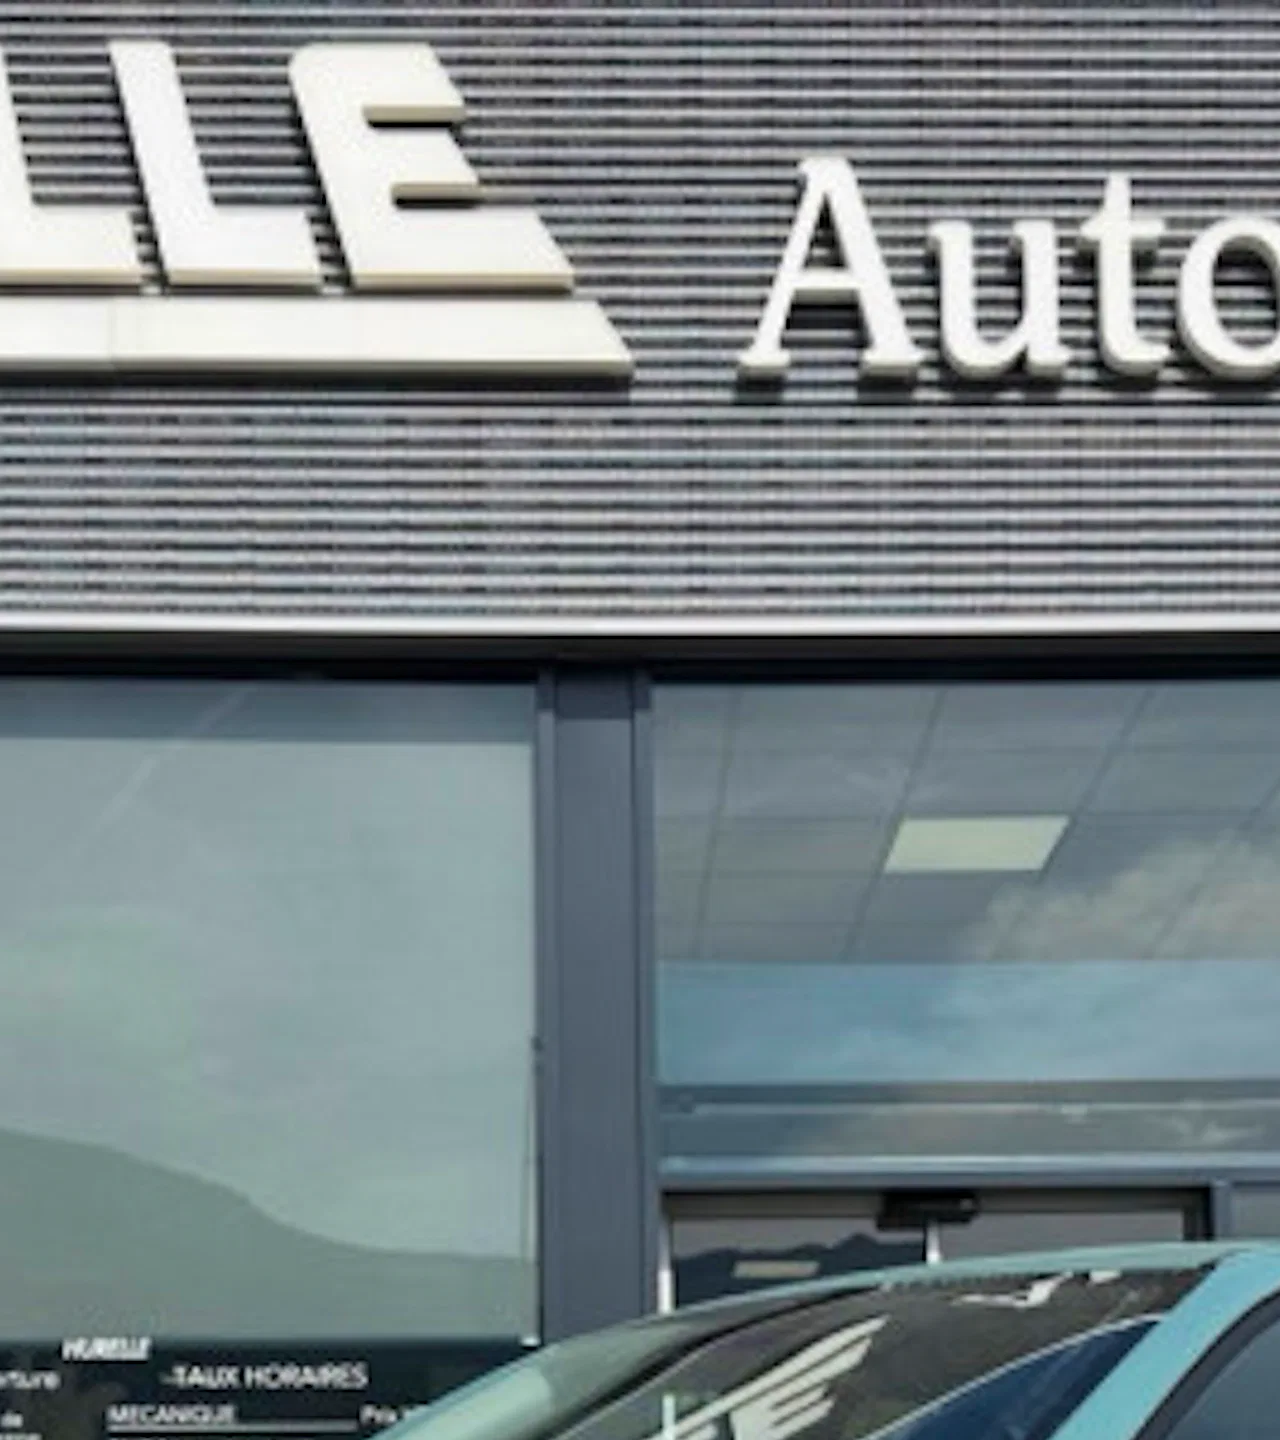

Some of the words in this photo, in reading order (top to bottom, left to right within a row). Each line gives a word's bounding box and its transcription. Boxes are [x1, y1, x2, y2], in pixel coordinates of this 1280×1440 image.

[172, 1364, 239, 1388] TAUX
[243, 1361, 369, 1390] HORAIRES
[106, 1404, 237, 1423] MECANIQUE
